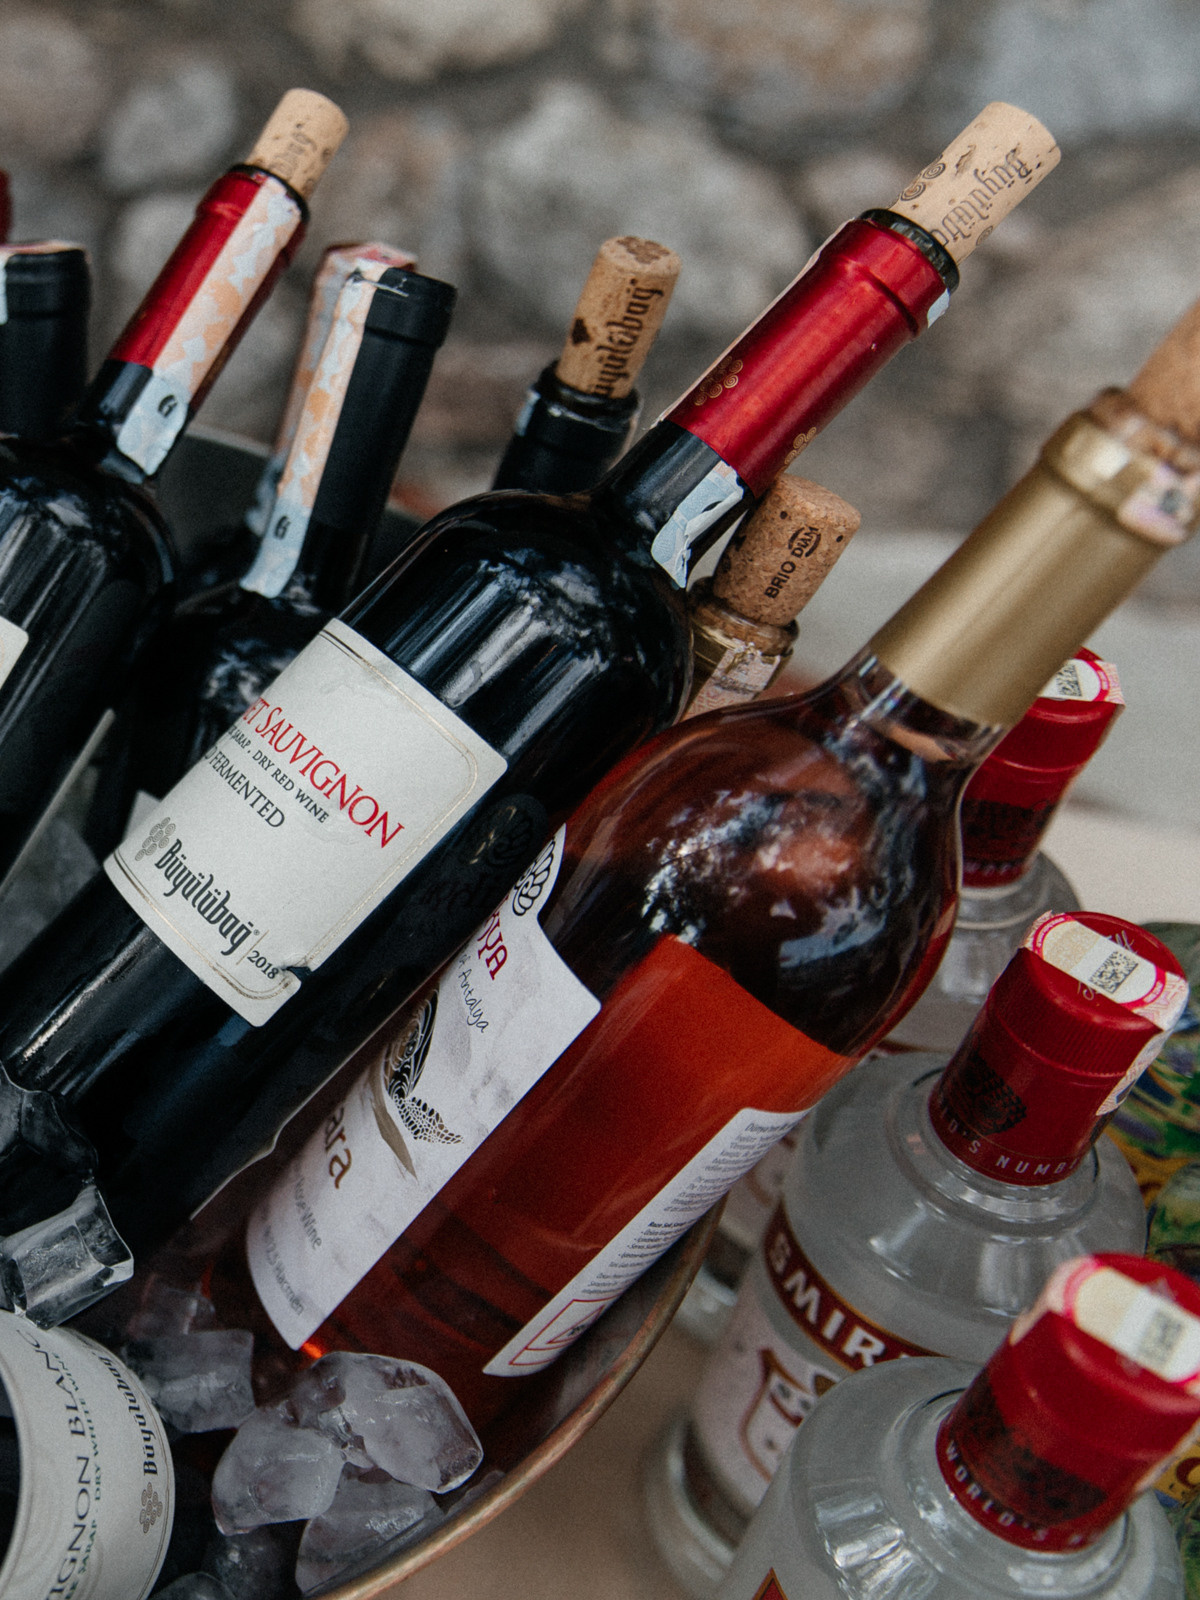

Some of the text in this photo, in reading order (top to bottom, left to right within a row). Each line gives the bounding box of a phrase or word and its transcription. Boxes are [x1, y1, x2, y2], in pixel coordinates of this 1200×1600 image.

[763, 560, 797, 599] BRIO
[209, 751, 285, 828] FERMENTED
[252, 750, 275, 771] DRY
[271, 768, 295, 791] RED
[294, 788, 329, 823] WINE
[255, 706, 406, 848] SAUVIGNON
[247, 950, 280, 979] 2018
[458, 968, 490, 1033] Antalya
[301, 1206, 322, 1250] Wine
[769, 1232, 910, 1367] SMIR
[16, 1329, 86, 1437] BLANC
[52, 1352, 79, 1392] WINE
[79, 1398, 98, 1456] WHITE
